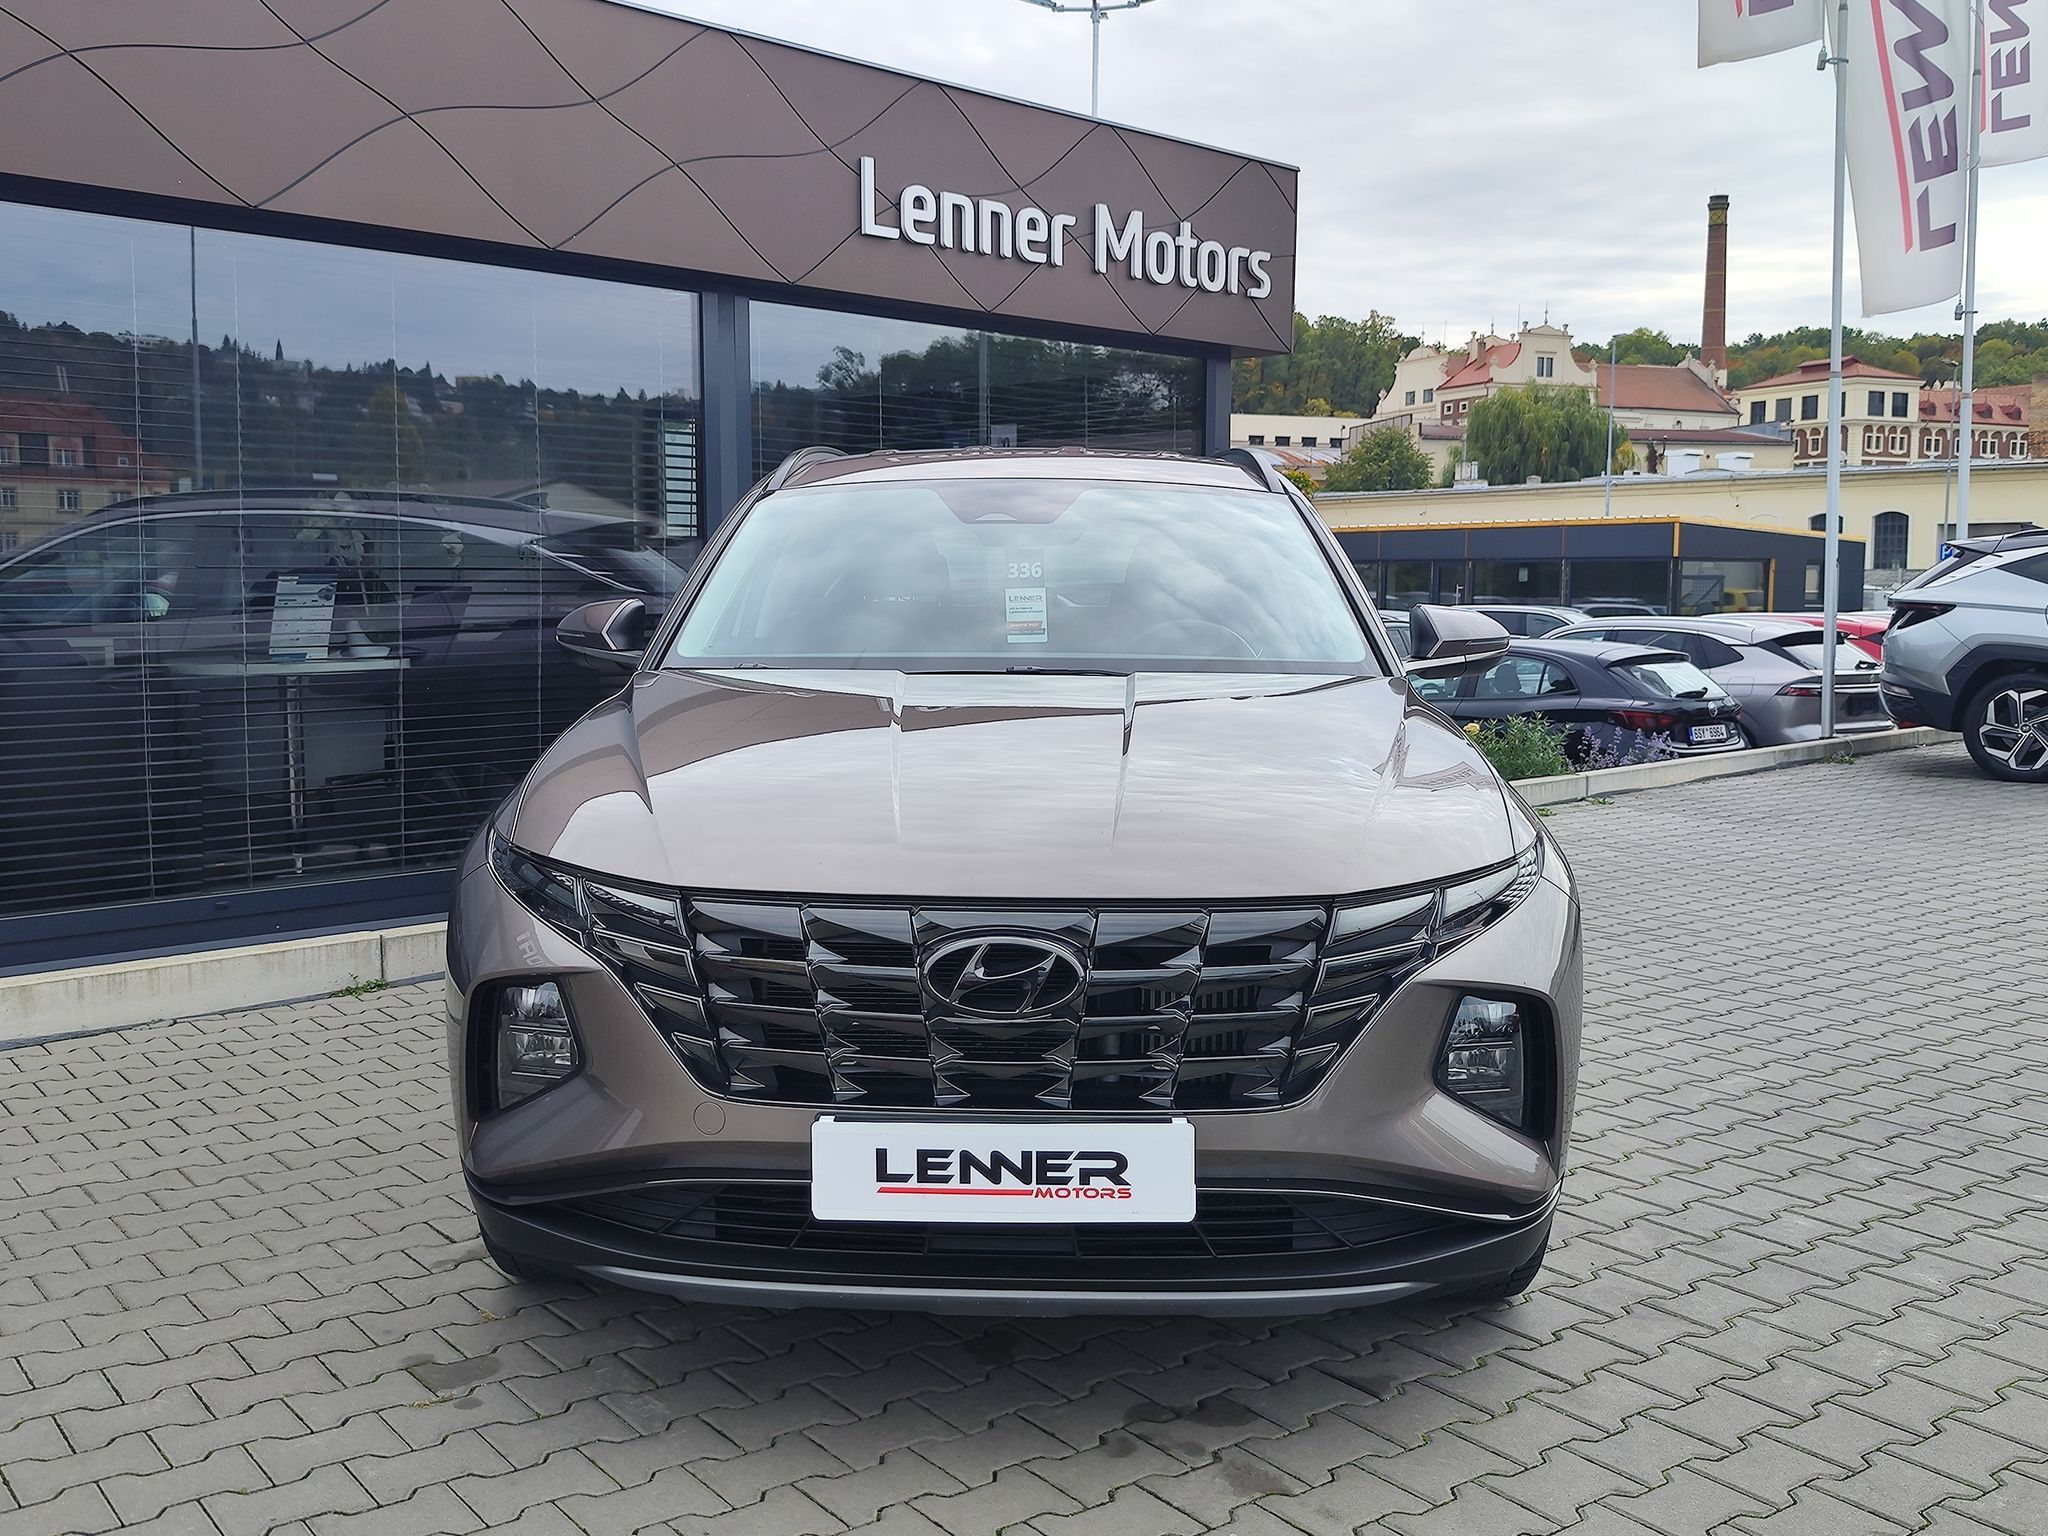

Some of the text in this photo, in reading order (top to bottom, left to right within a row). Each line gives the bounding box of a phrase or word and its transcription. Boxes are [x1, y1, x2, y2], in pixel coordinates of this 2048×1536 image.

[860, 156, 1272, 299] Lenner Motors
[1008, 562, 1043, 578] 336
[876, 1147, 1131, 1186] LENNER
[1034, 1187, 1132, 1199] MOTORS
